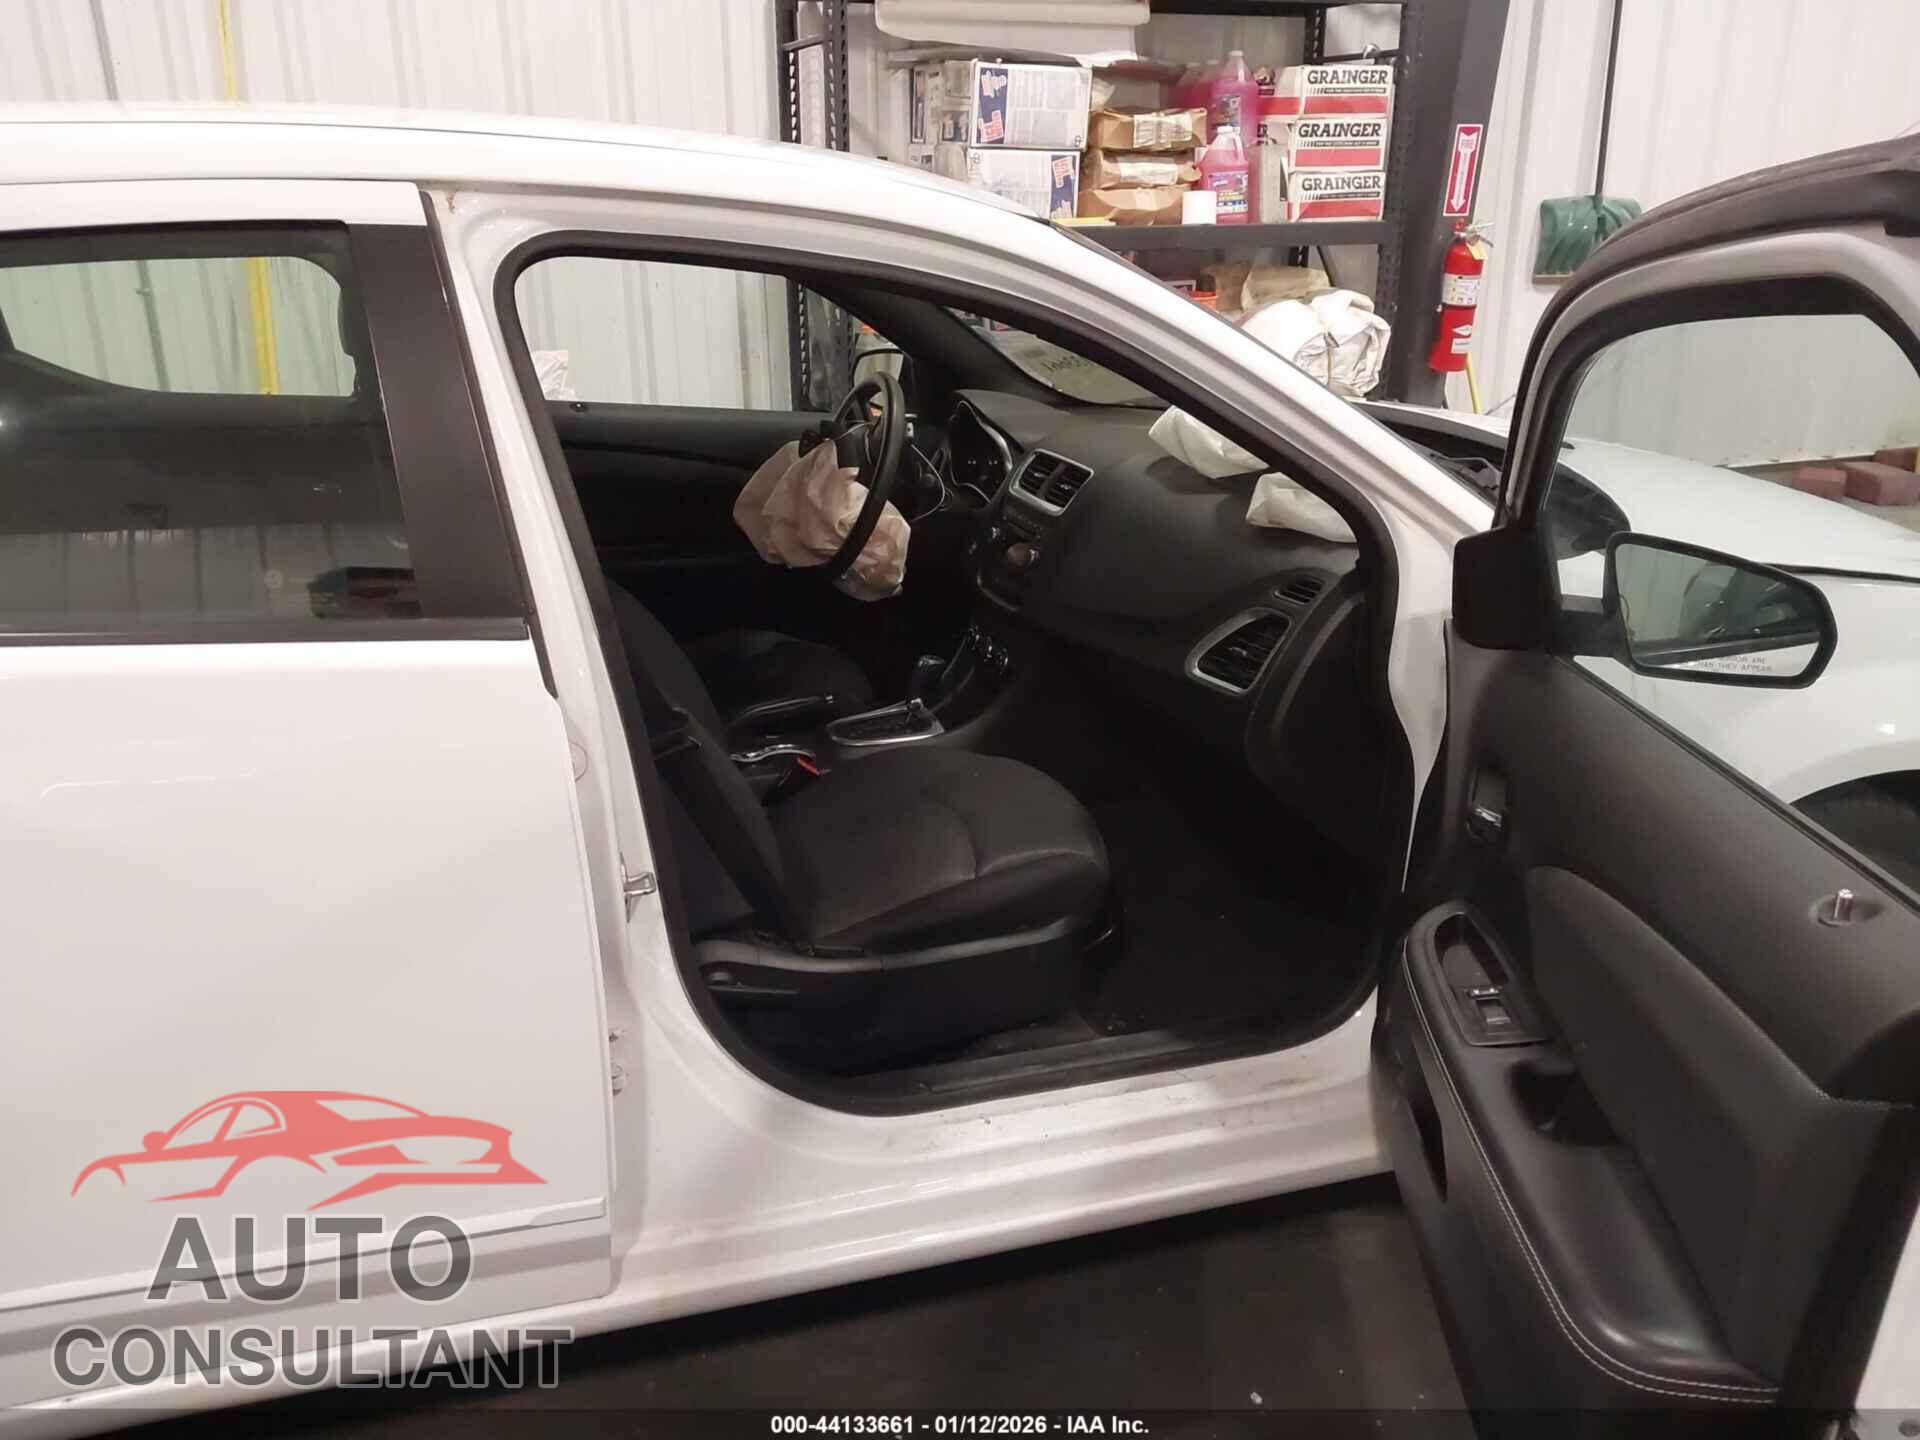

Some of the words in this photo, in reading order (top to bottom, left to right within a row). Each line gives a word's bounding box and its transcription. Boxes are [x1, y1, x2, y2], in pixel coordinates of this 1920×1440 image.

[1307, 70, 1388, 85] GRAINGER
[1298, 123, 1382, 138] GRAINGER
[1302, 176, 1382, 191] GRAINGER
